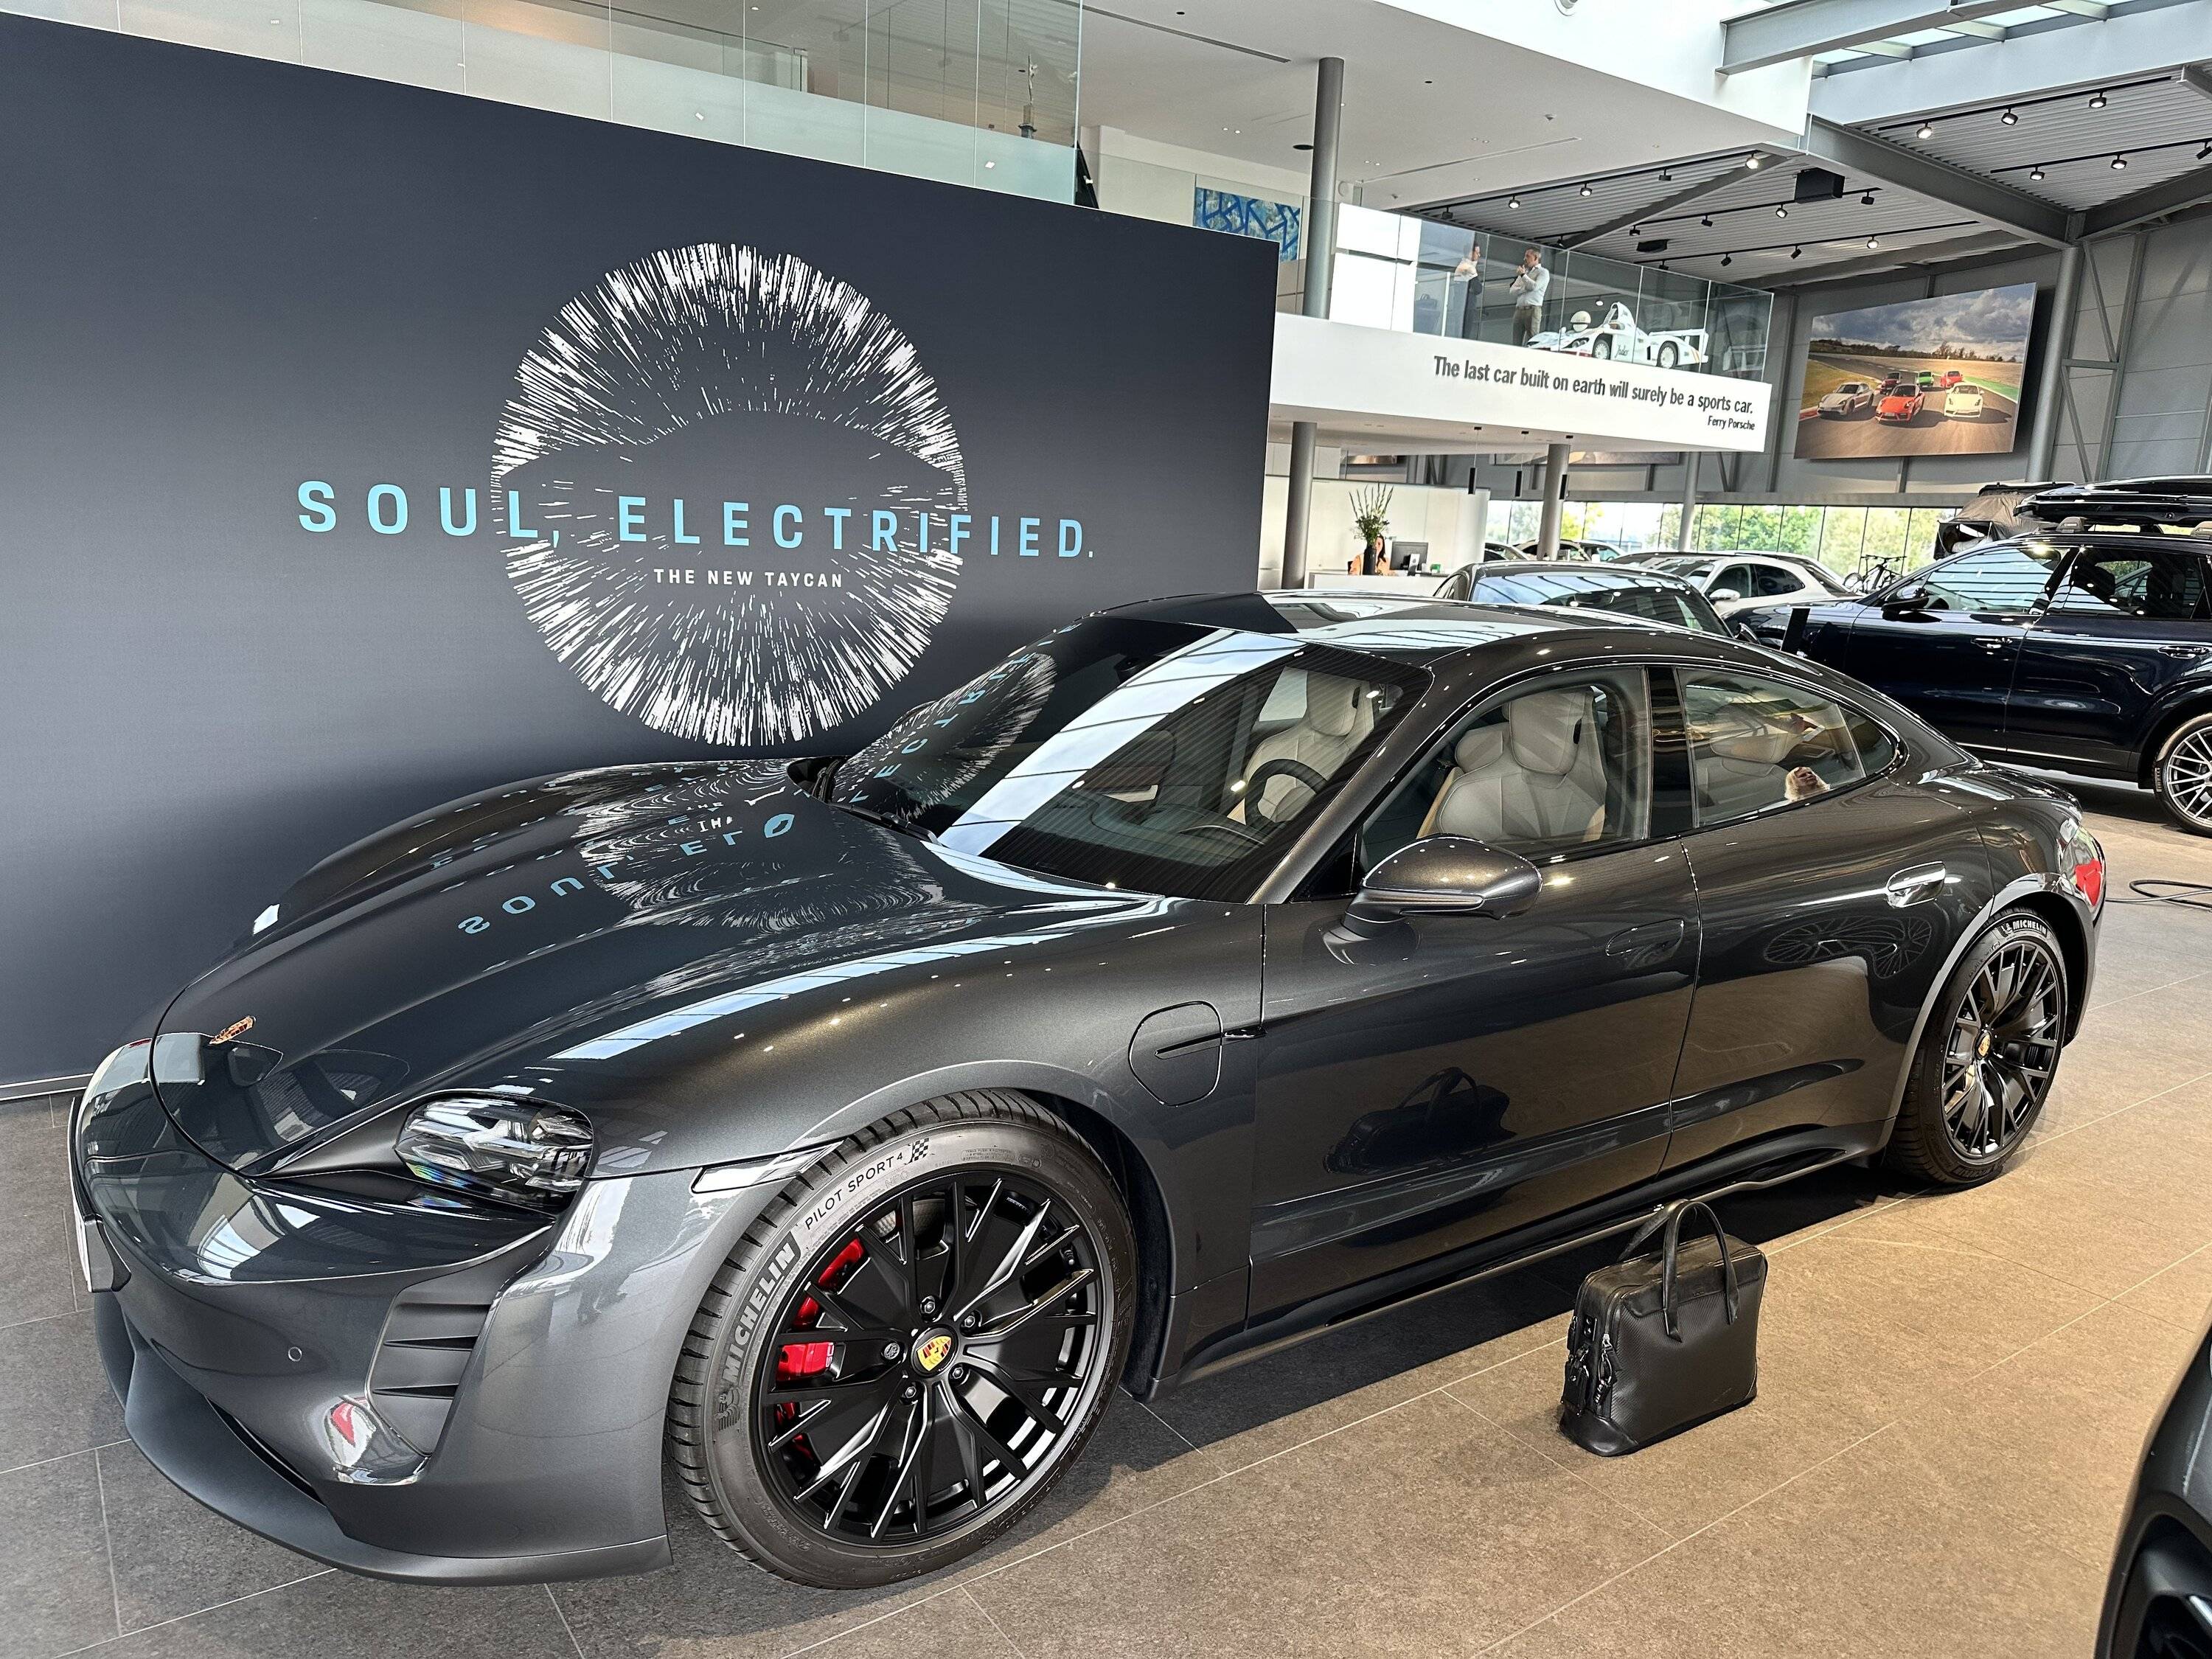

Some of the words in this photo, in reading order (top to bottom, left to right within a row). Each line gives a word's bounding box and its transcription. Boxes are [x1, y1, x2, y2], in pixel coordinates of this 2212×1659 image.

[1434, 355, 1460, 377] The
[1464, 360, 1490, 381] last
[1494, 369, 1517, 384] car
[1520, 367, 1549, 389] built
[1553, 377, 1568, 391] on
[1573, 378, 1605, 395] earth
[1610, 380, 1629, 398] will
[1632, 386, 1667, 407] surely
[1670, 388, 1684, 405] be
[1687, 394, 1694, 406] a
[1698, 396, 1731, 412] sports
[1734, 400, 1753, 414] car.
[1708, 415, 1726, 430] Ferry
[1728, 418, 1756, 431] Porsche
[298, 480, 560, 548] SOUL,
[618, 495, 1094, 558] ELECTRIFIED.
[653, 568, 695, 585] THE
[708, 570, 753, 586] NEW
[765, 571, 842, 588] TAYCAN
[2012, 919, 2047, 935] MICHELIN
[804, 1189, 842, 1231] PILOT
[848, 1157, 894, 1193] SPORT
[897, 1152, 903, 1161] 4
[722, 1242, 796, 1385] MICHELIN
